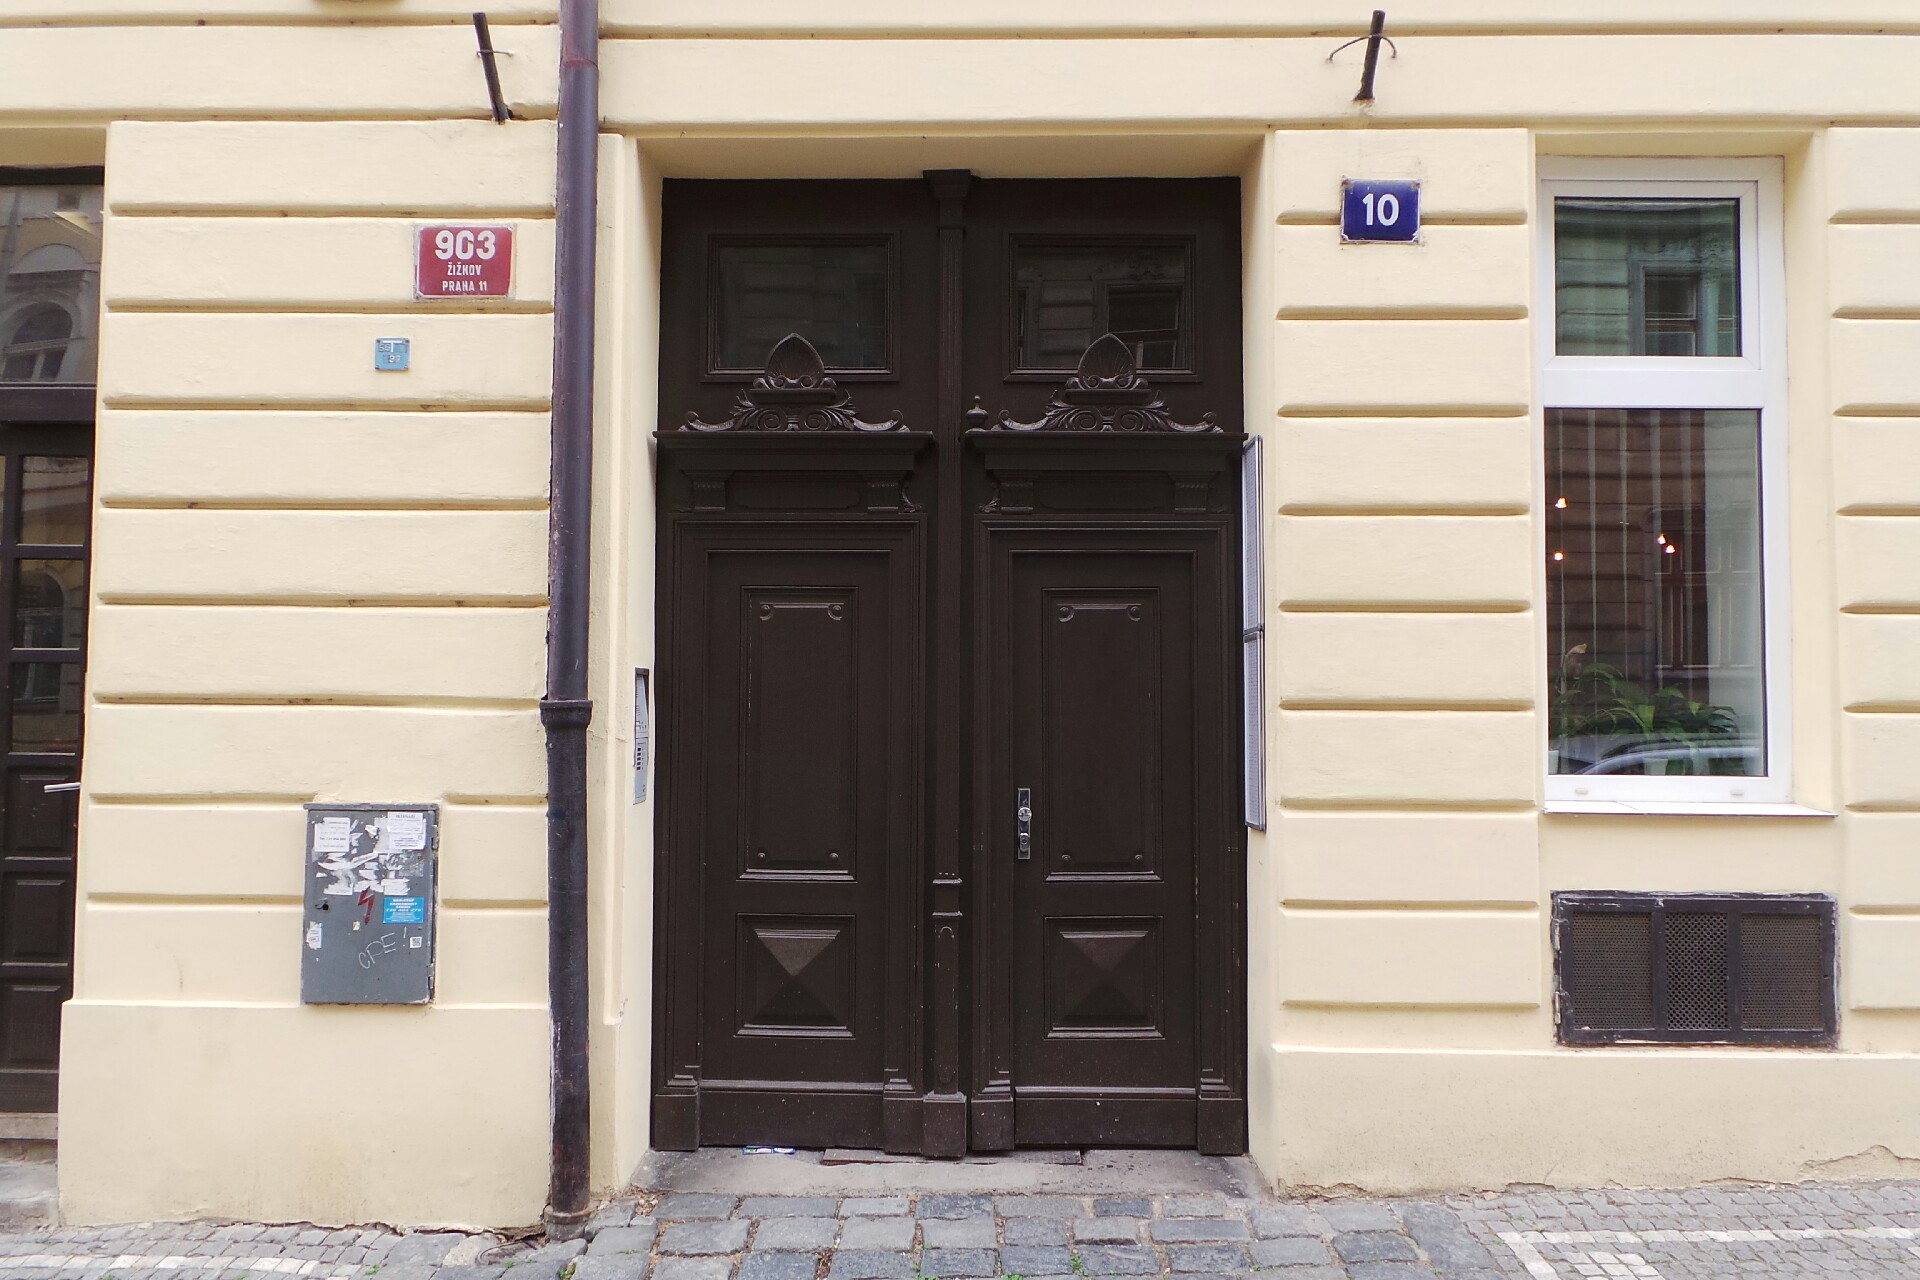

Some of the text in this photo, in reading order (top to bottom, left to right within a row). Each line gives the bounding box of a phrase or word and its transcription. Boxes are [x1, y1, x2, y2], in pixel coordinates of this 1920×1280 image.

[1362, 193, 1399, 226] 10
[435, 230, 496, 260] 903
[447, 262, 482, 276] ŽIŽKOV
[442, 281, 488, 292] PRAHA 11
